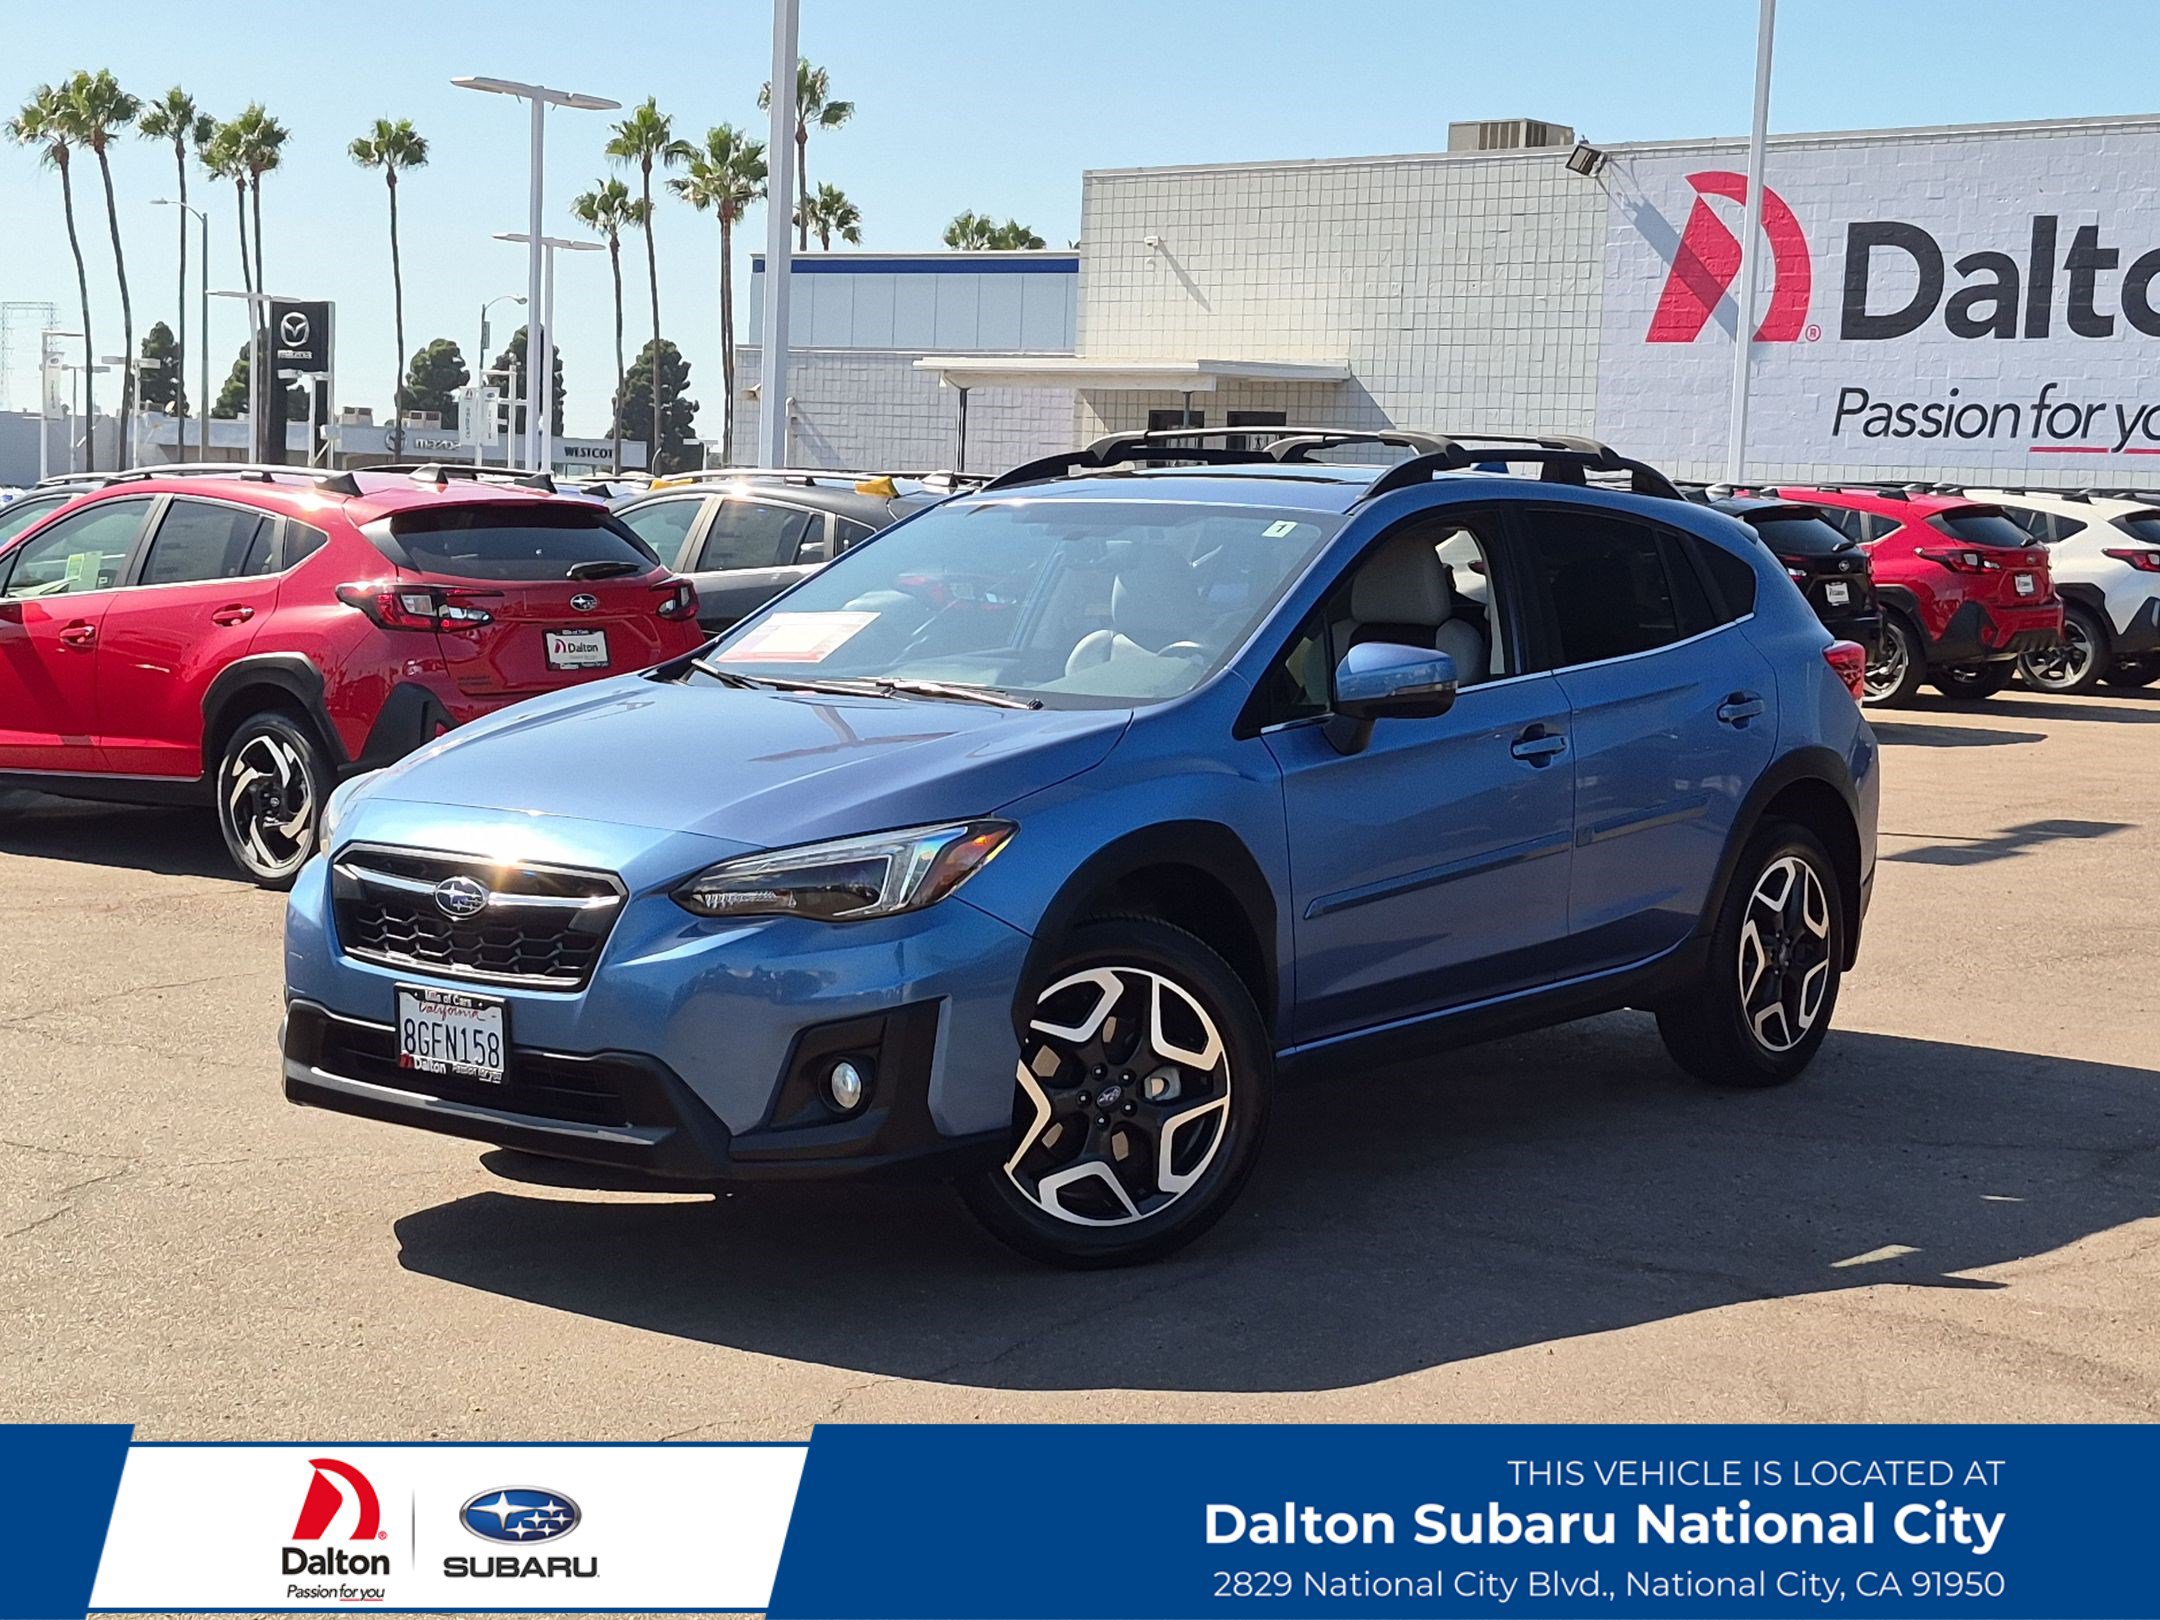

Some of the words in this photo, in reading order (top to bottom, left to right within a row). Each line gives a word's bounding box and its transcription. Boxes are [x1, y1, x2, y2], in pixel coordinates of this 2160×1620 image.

[1832, 387, 2020, 439] Passion
[2030, 382, 2107, 439] for
[567, 641, 599, 653] Dalton
[403, 1018, 500, 1069] 8GFN158
[414, 1057, 447, 1075] Dalton
